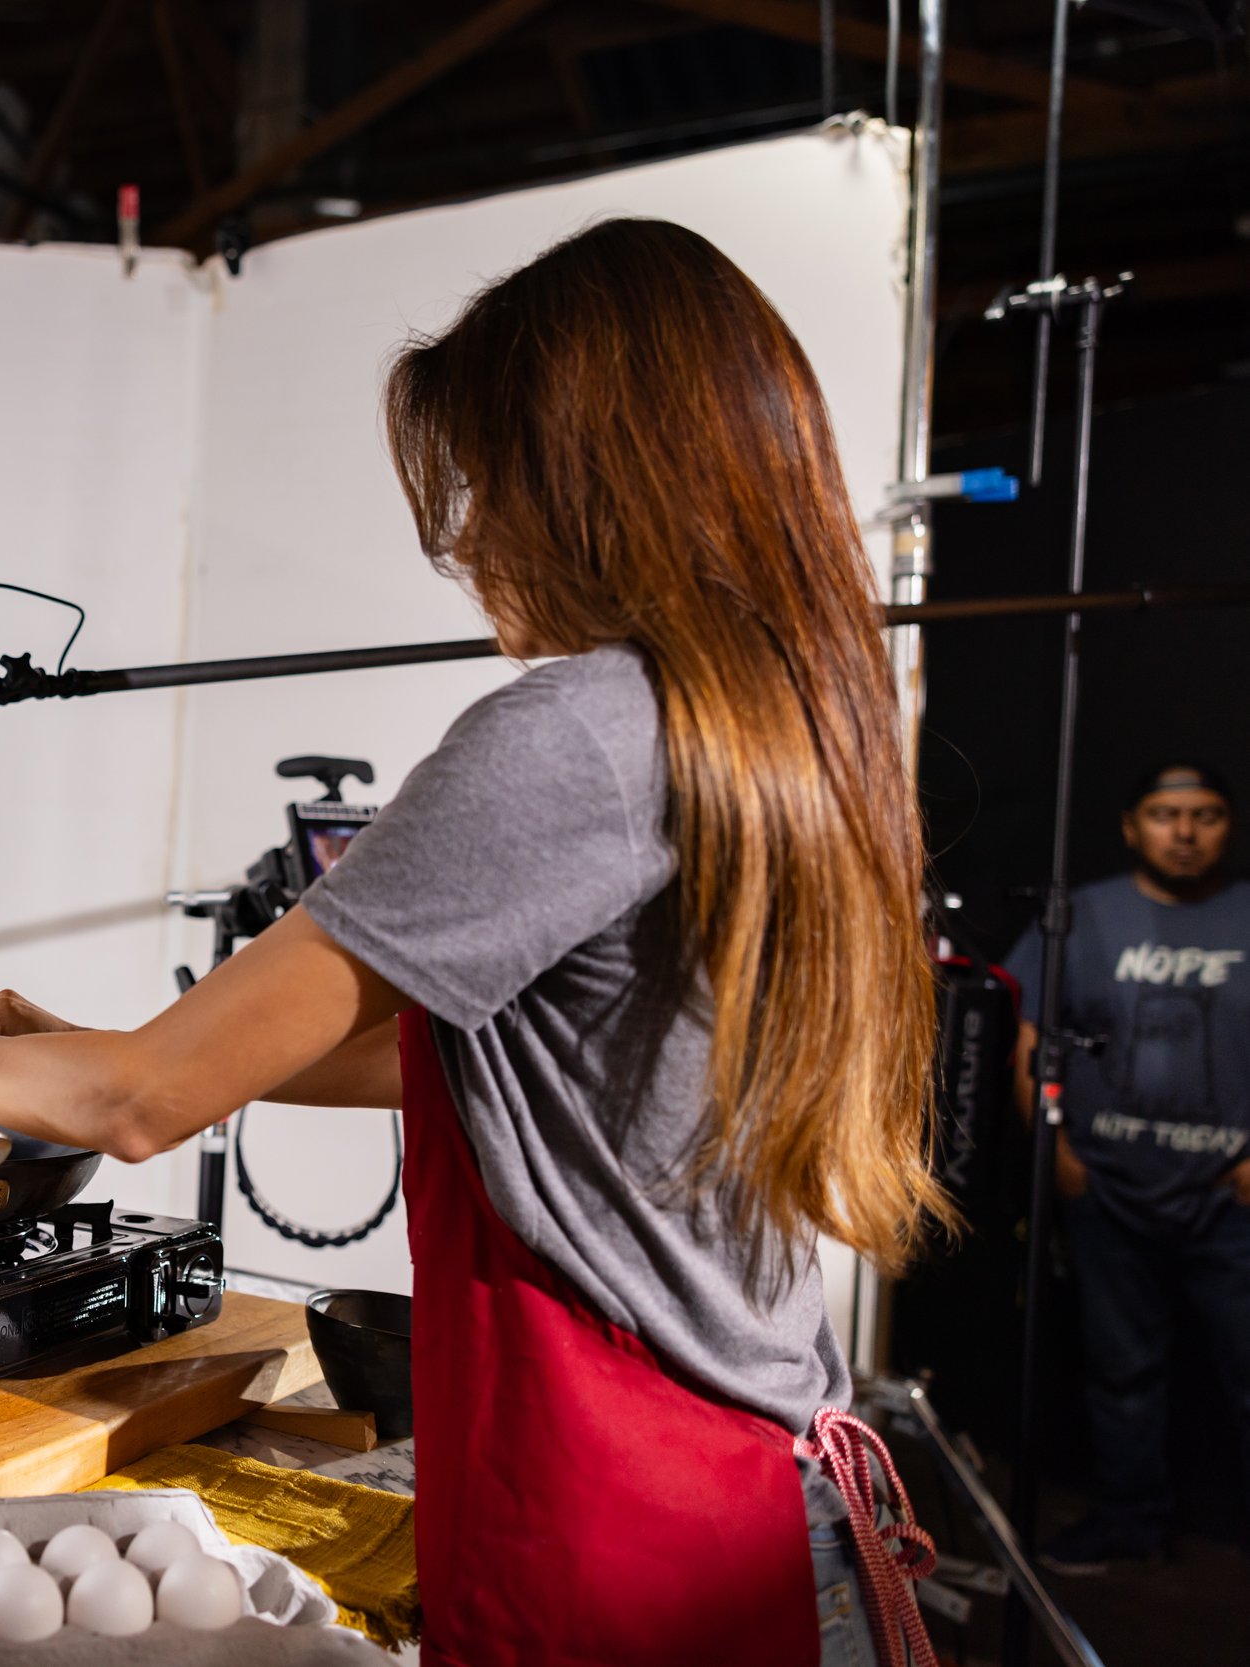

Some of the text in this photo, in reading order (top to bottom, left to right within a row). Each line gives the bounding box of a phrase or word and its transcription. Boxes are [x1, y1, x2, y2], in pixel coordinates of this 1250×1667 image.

[1115, 941, 1245, 987] NOPE
[1091, 1112, 1249, 1158] NOT TODAY
